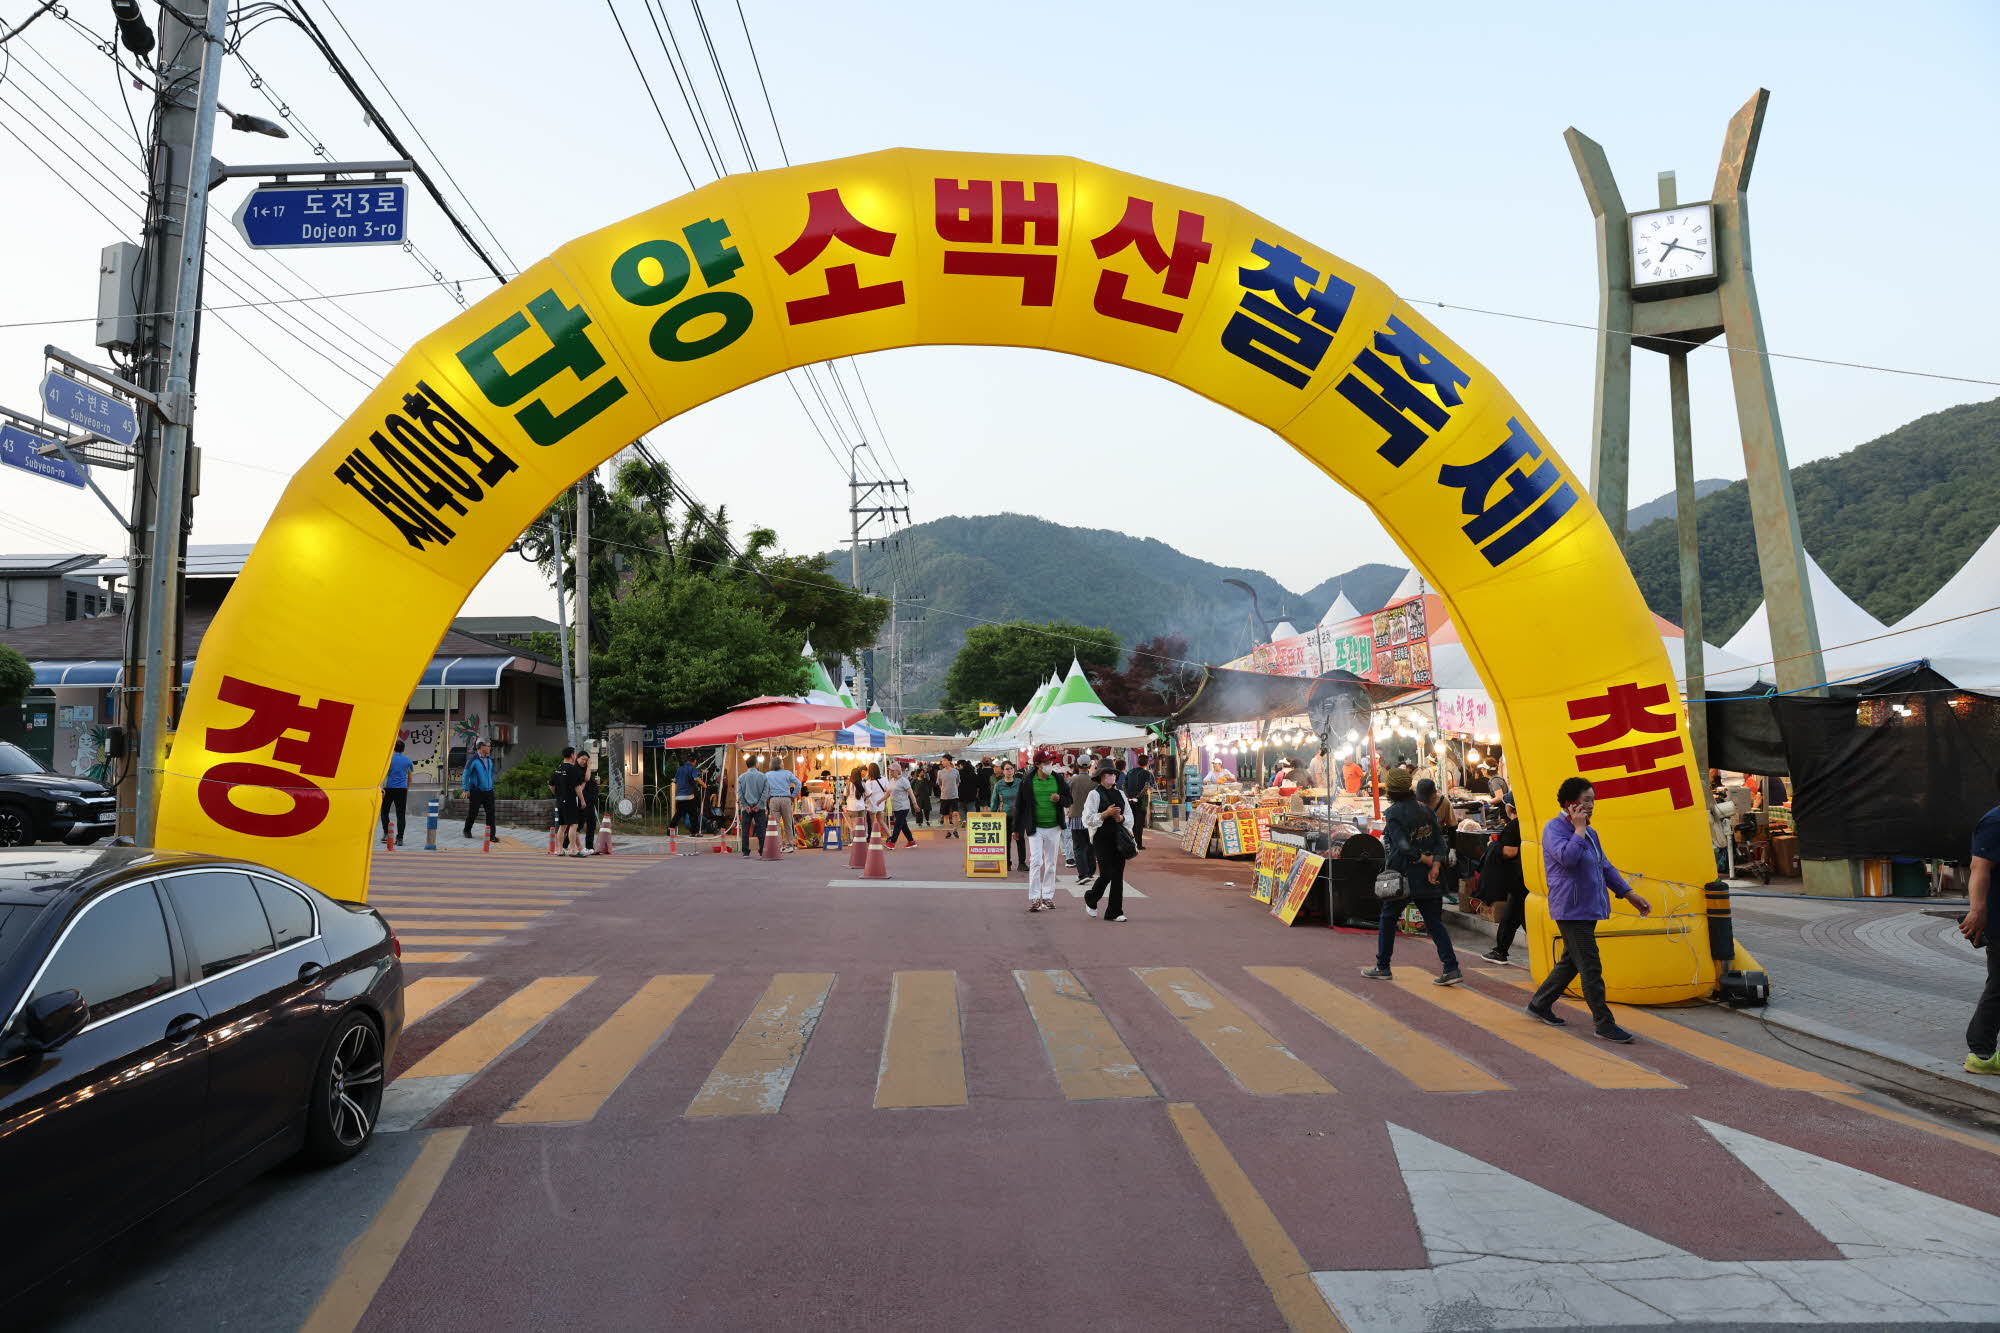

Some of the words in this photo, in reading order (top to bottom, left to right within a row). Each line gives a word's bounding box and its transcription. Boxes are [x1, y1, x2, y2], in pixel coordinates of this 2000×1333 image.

[303, 192, 397, 218] 도전3로
[302, 223, 357, 241] Dojeon
[363, 222, 396, 237] 3-ro
[334, 380, 519, 551] 제40회
[456, 217, 754, 447] 단양
[774, 177, 1212, 334] 소백산
[49, 388, 59, 402] 41
[74, 389, 109, 416] 수변로
[70, 408, 111, 433] Subyeon-ro
[122, 419, 132, 433] 45
[3, 438, 14, 453] 43
[25, 456, 65, 478] Subyeon-ro
[410, 728, 433, 745] 단양
[1567, 682, 1694, 810] 축
[198, 675, 354, 837] 경
[972, 822, 1002, 831] 주정차
[974, 832, 1000, 844] 금지
